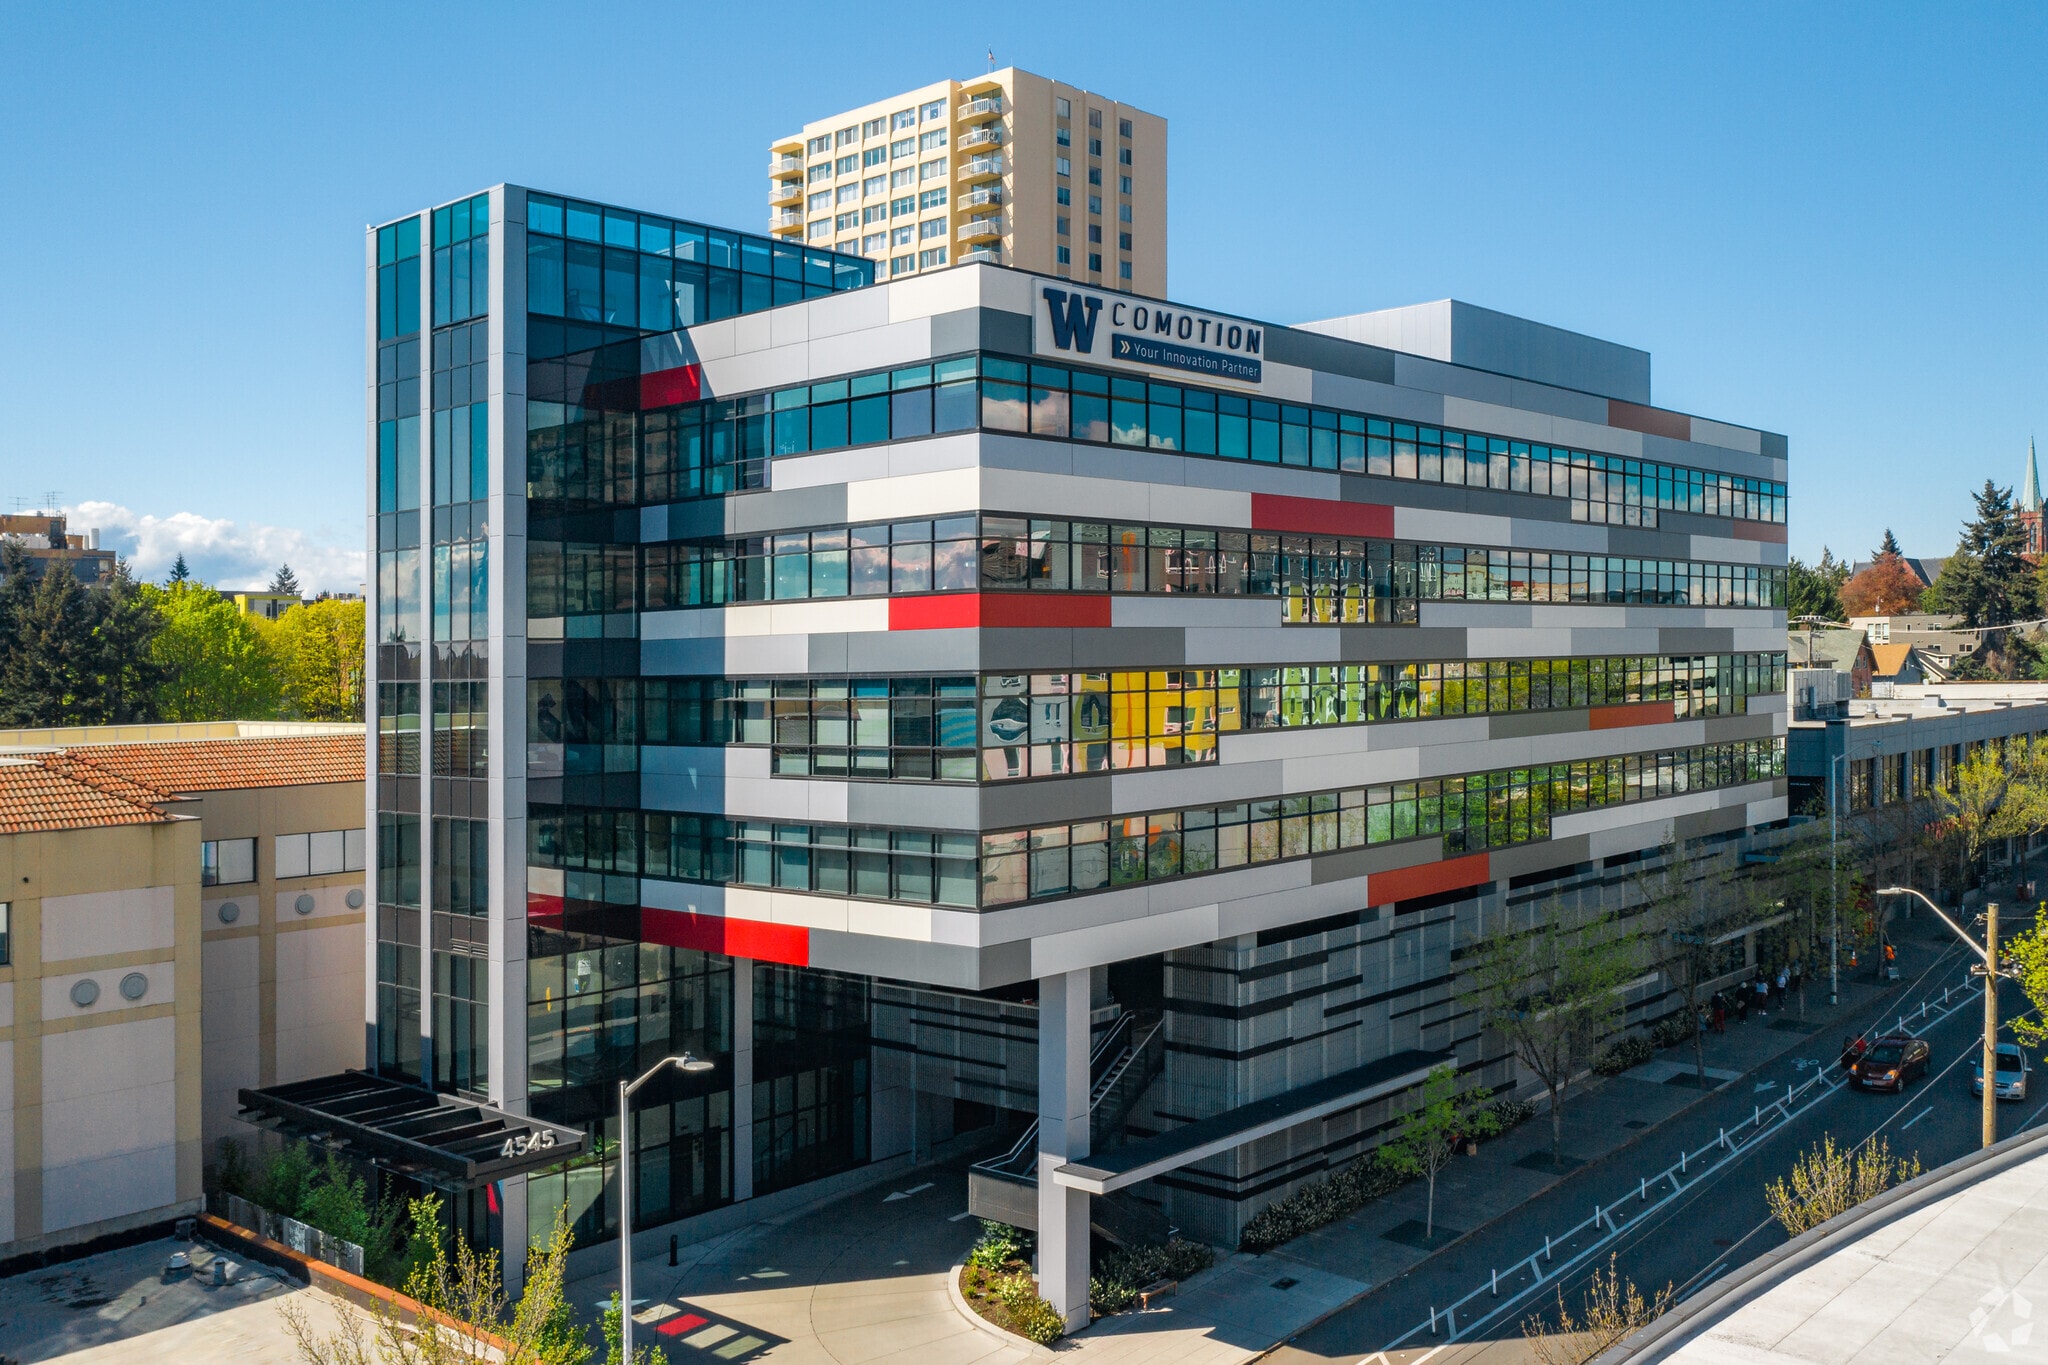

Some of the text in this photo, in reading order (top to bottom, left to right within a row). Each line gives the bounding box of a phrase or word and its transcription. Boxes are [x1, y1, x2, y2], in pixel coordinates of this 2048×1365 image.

[1043, 287, 1103, 354] W
[1112, 302, 1261, 354] COMOTION
[1134, 343, 1258, 377] Your Innovation Partner
[501, 1129, 555, 1158] 4545
